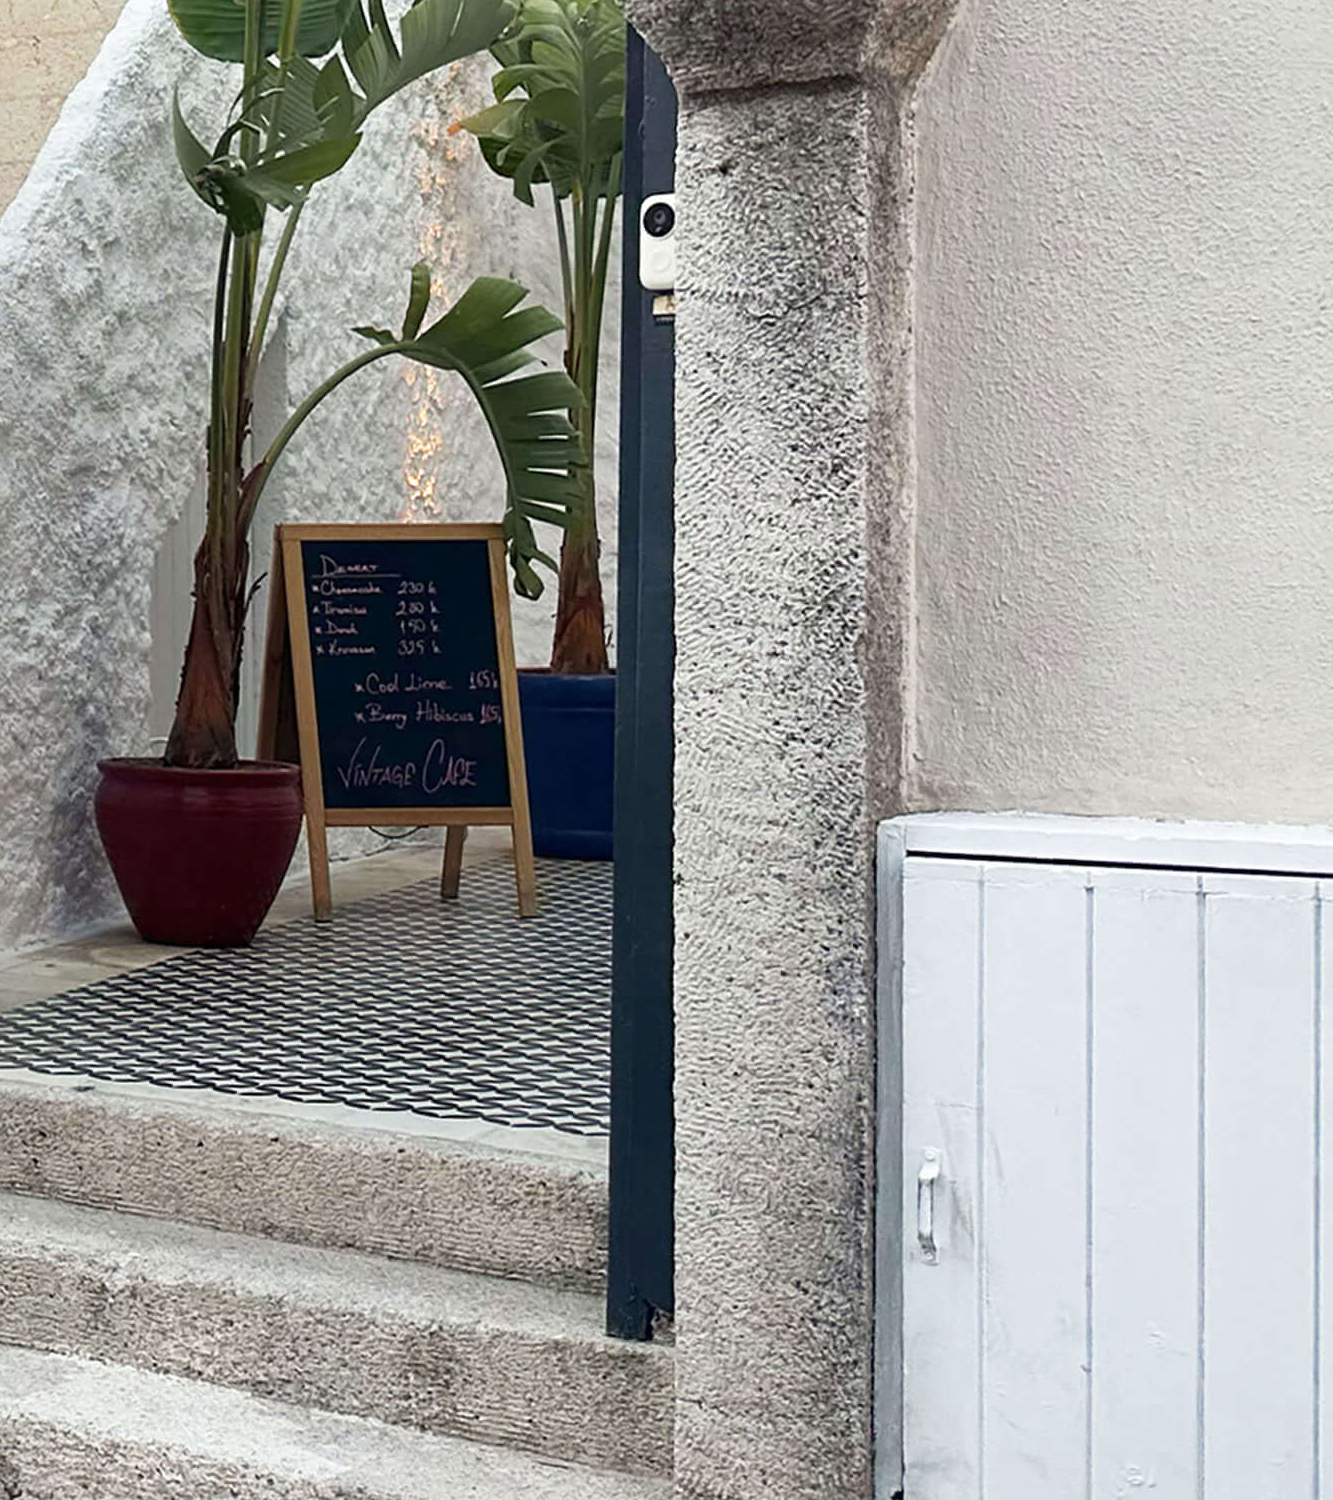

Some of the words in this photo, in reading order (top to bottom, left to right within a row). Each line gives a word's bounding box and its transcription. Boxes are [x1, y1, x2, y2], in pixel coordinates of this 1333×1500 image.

[365, 672, 399, 694] Cool
[405, 673, 453, 692] Lime
[365, 702, 408, 729] Berry
[416, 699, 475, 722] Hibiscus
[338, 737, 416, 788] VINTAGE
[422, 738, 477, 793] CAFE
